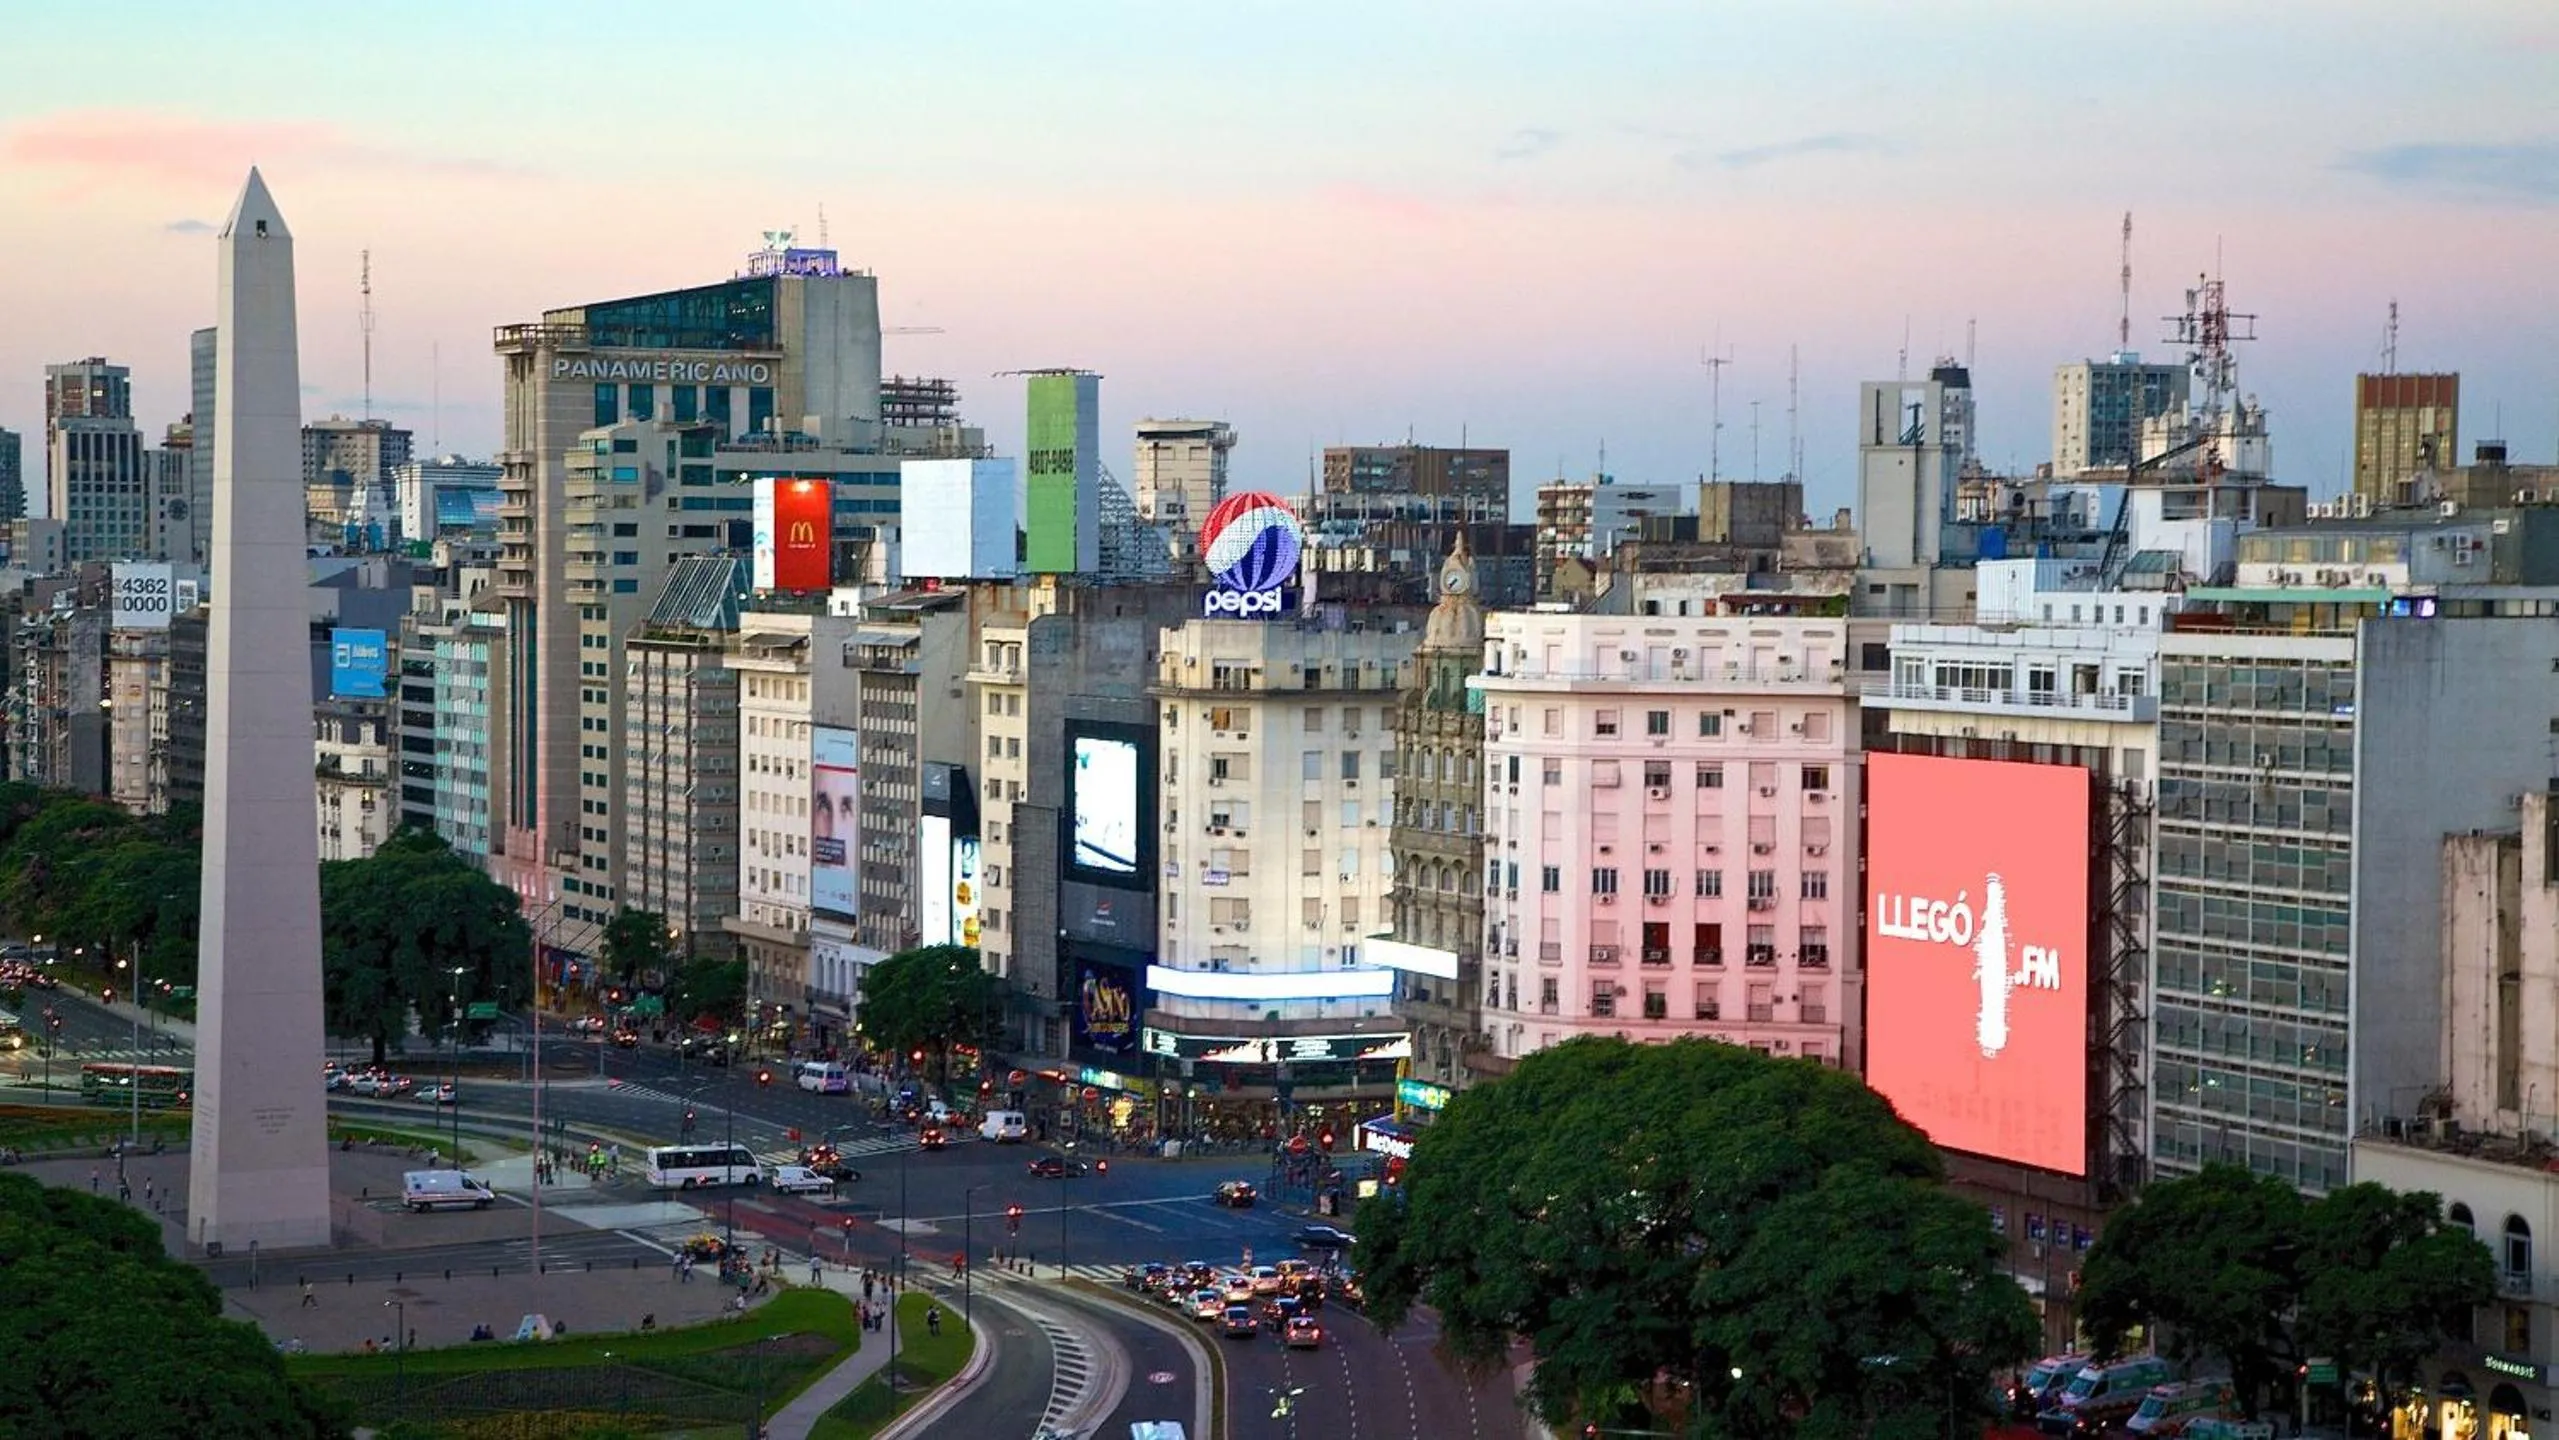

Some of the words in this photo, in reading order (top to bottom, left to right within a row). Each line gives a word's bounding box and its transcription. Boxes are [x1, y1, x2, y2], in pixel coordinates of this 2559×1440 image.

[554, 357, 769, 383] PANAMERICANO
[122, 578, 167, 594] 4362
[122, 596, 168, 612] 0000
[1204, 585, 1282, 617] pepsi
[1878, 890, 1973, 947] LLEGÓ
